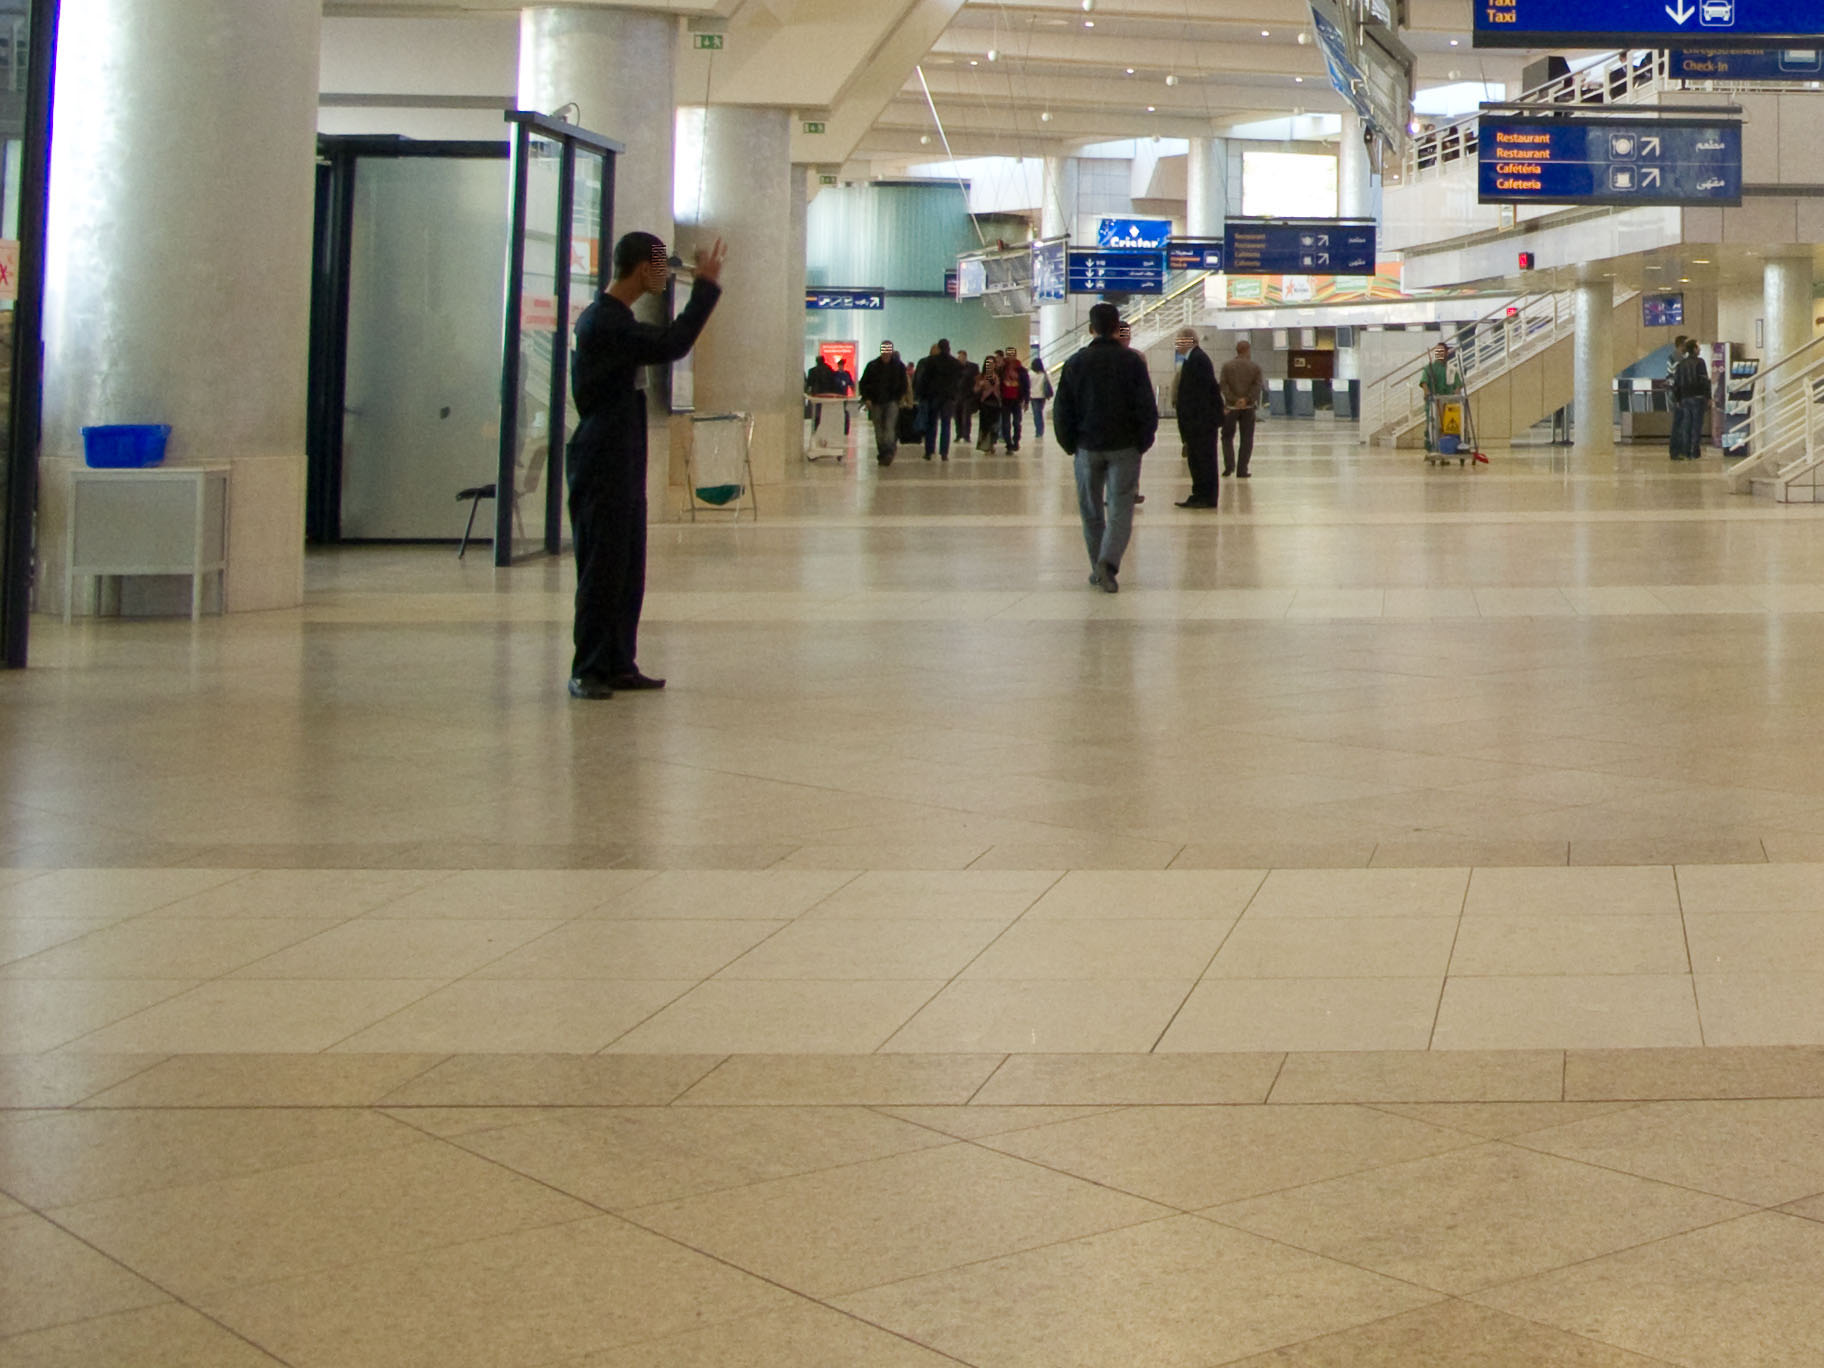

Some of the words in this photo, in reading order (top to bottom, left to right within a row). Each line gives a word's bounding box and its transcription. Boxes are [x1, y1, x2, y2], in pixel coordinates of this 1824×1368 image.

[1486, 9, 1517, 23] Taxi
[1496, 132, 1550, 144] Restaurant
[1695, 140, 1725, 153] مطعم
[1496, 147, 1550, 159] Restaurant
[1496, 178, 1541, 190] Cafeteria
